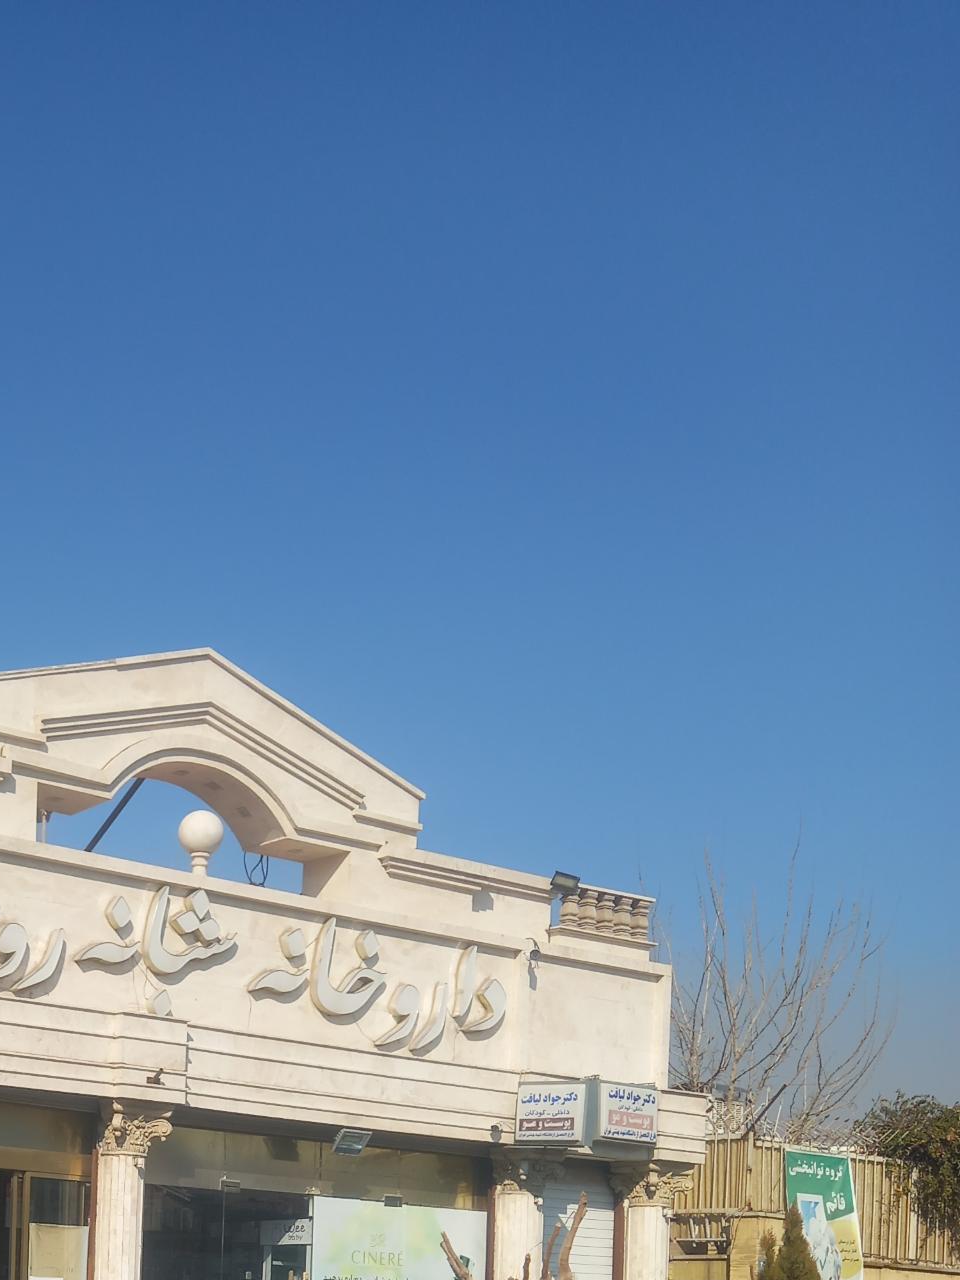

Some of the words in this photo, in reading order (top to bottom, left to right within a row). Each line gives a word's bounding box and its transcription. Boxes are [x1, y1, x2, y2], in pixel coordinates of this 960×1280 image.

[74, 885, 237, 1016] شبانه
[248, 916, 506, 1053] داروخانه
[543, 1092, 561, 1106] جواد
[561, 1091, 578, 1106] دکتر
[627, 1092, 641, 1106] جواد
[642, 1094, 656, 1107] دکتر
[544, 1117, 571, 1130] پوست
[788, 1160, 824, 1179] توانبخشی
[825, 1165, 843, 1181] گروه
[825, 1191, 845, 1214] قائم
